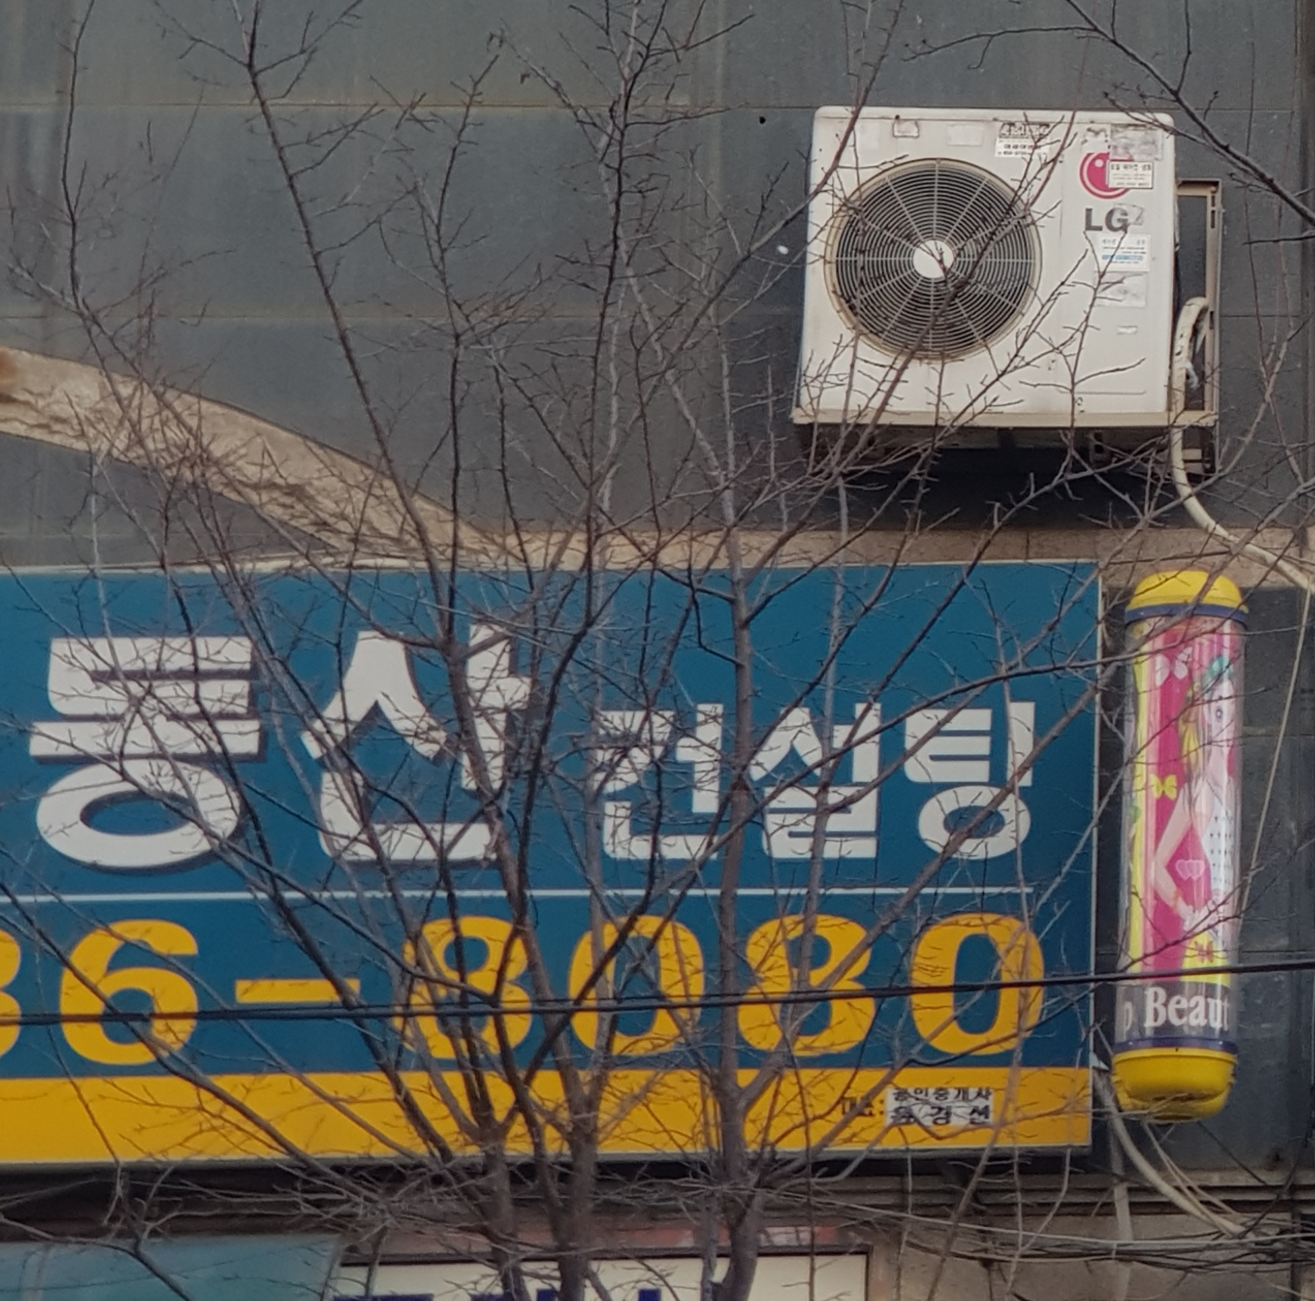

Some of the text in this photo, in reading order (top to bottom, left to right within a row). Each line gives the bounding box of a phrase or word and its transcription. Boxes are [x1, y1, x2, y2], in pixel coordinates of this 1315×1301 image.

[1085, 207, 1129, 232] LG
[594, 702, 1036, 861] 컨설팅
[0, 912, 1046, 1065] 6-8080
